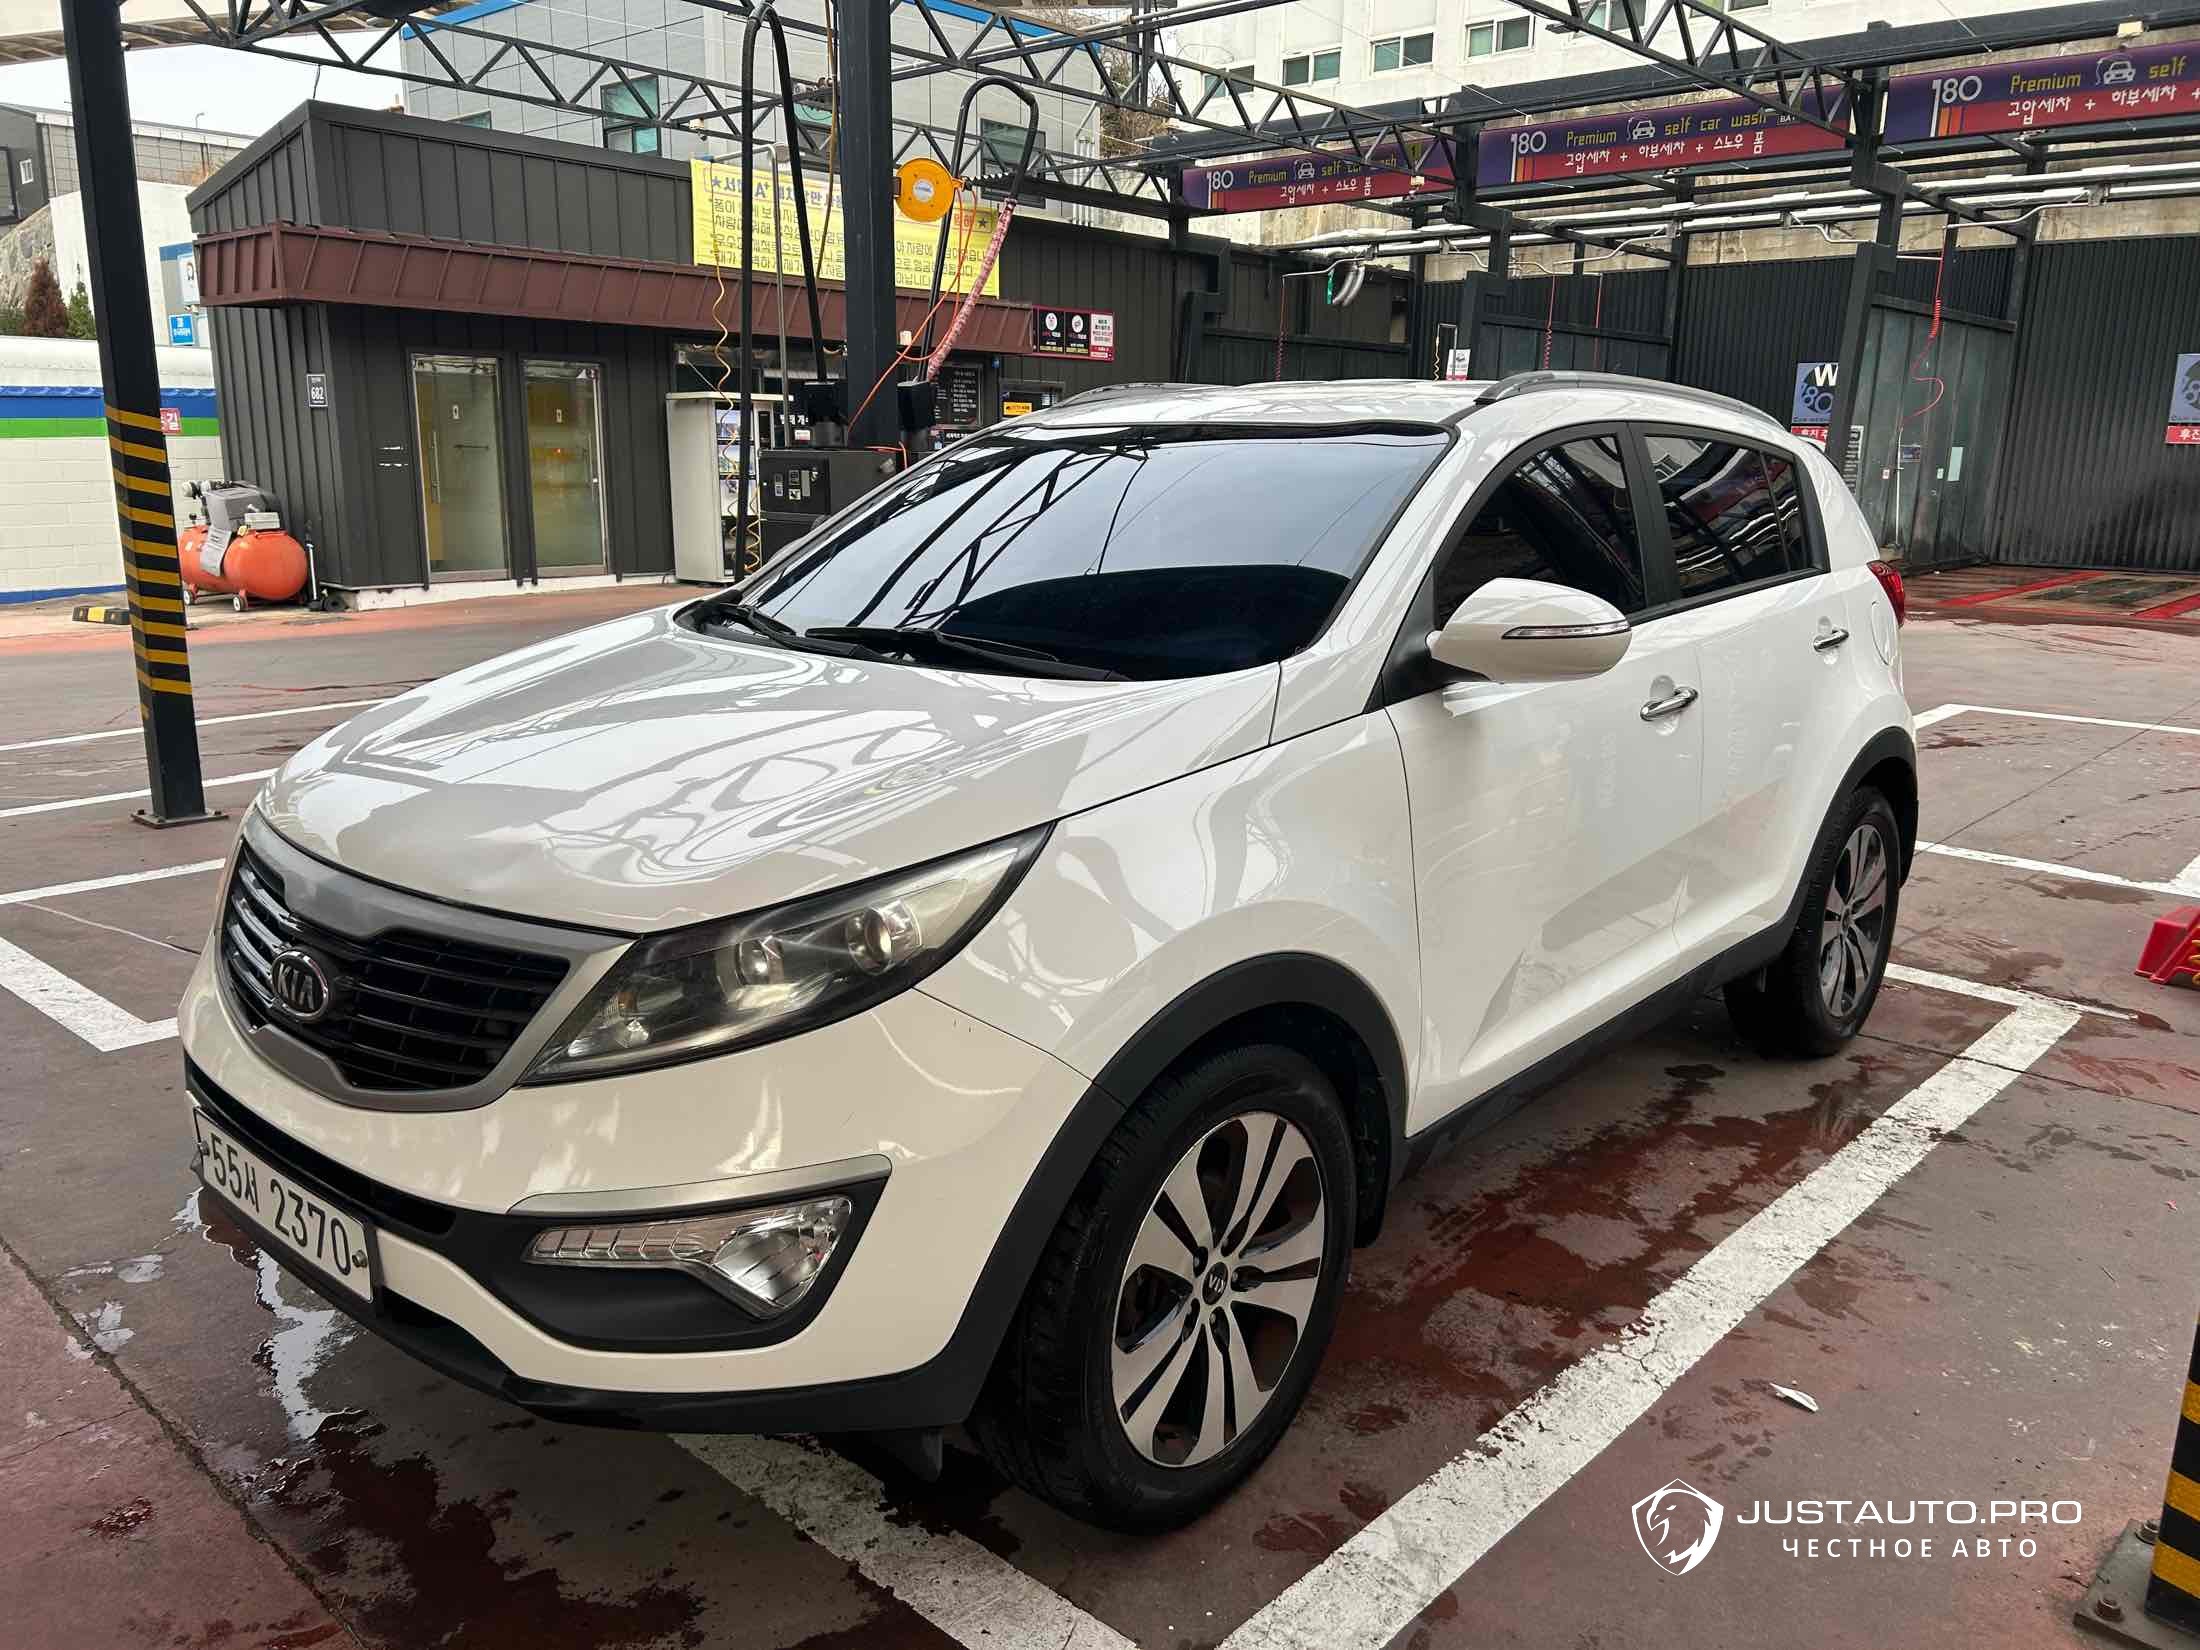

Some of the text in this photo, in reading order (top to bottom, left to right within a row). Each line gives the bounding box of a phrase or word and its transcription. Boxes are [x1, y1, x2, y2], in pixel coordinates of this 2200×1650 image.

[2010, 72, 2081, 94] Premium
[2149, 56, 2187, 79] self
[2008, 95, 2071, 125] 고압세차
[2112, 84, 2177, 107] 하부세차
[1566, 130, 1617, 148] Premium
[1664, 114, 1692, 136] self
[1700, 118, 1721, 132] car
[1712, 133, 1744, 150] 스노우
[1248, 169, 1288, 185] Premium
[311, 386, 324, 400] 682
[211, 1133, 351, 1276] 55서 2370
